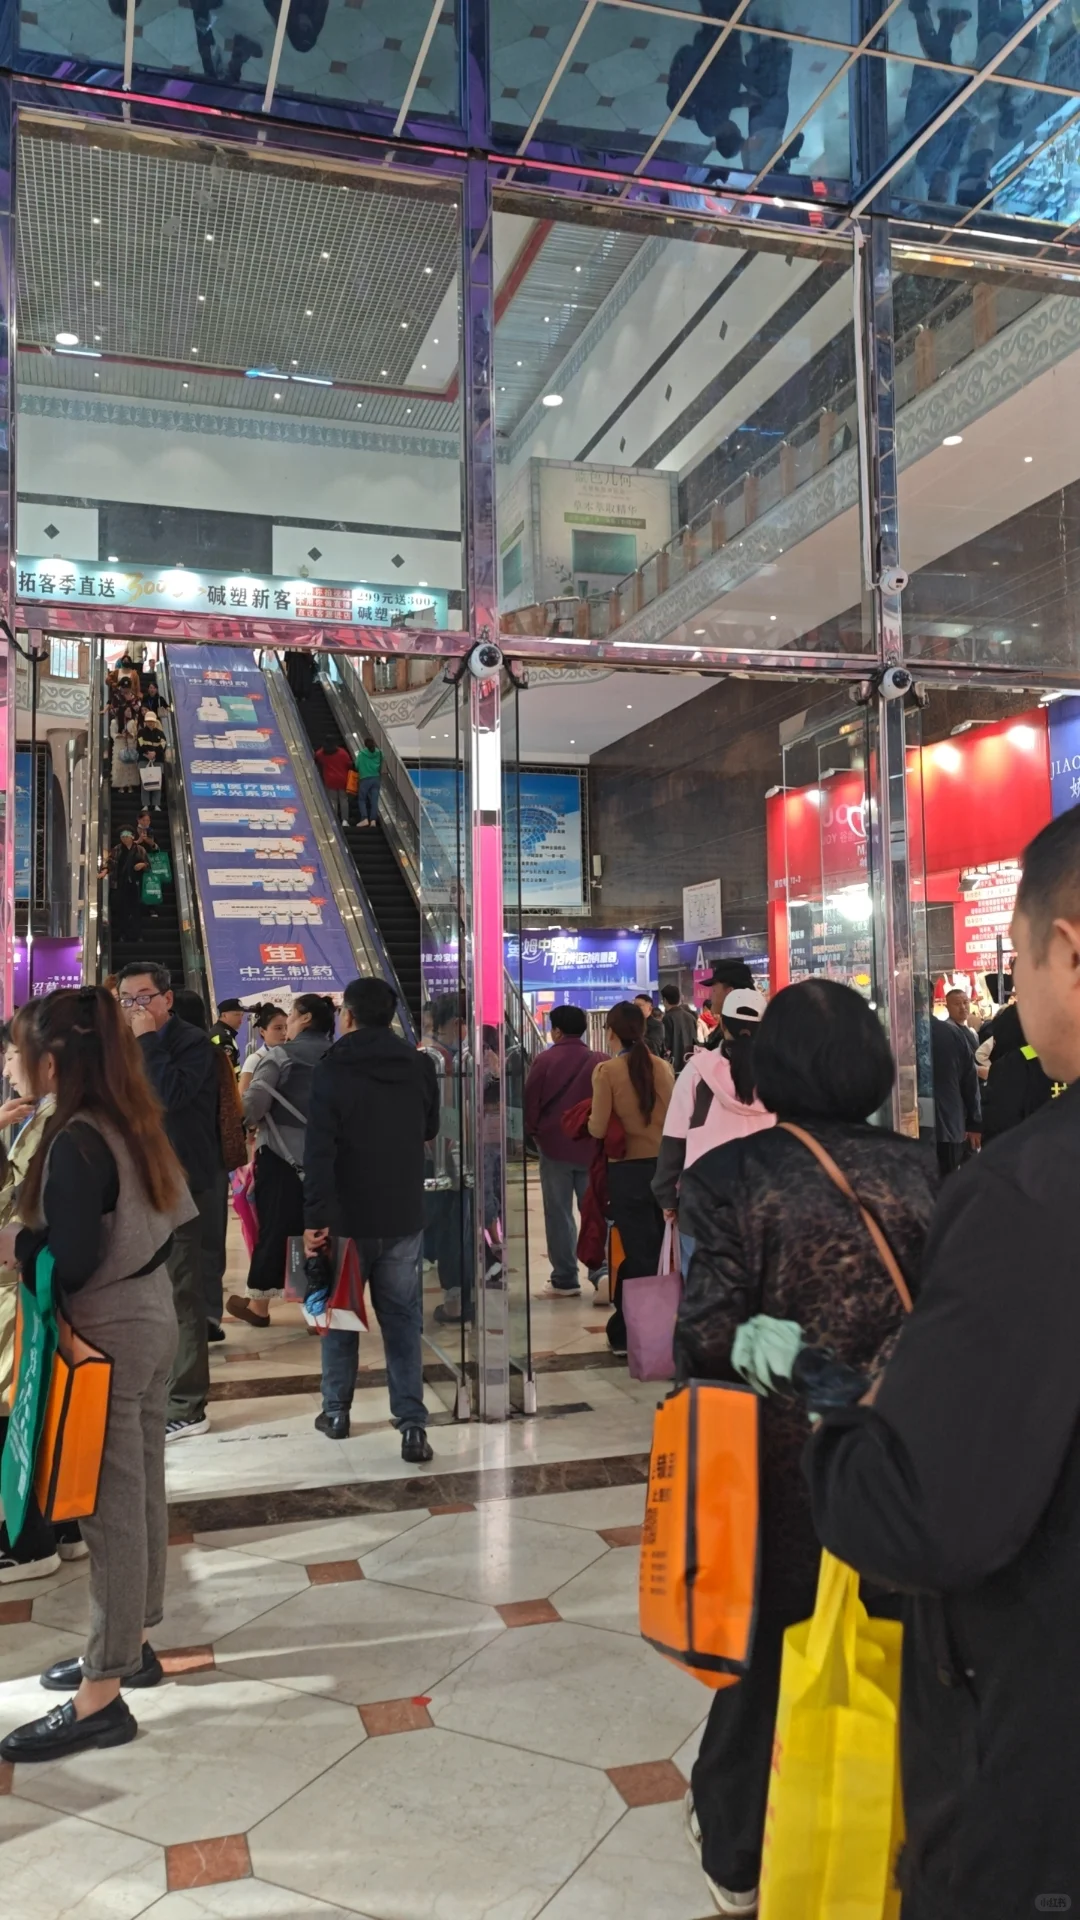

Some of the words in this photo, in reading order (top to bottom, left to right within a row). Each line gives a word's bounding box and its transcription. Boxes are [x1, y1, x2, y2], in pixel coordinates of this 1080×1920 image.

[18, 570, 116, 598] 拓客季直送
[207, 585, 291, 611] 碱塑新客
[194, 782, 291, 792] 二类医疗器械
[211, 790, 277, 798] 水光系列
[239, 965, 333, 978] 中生制药
